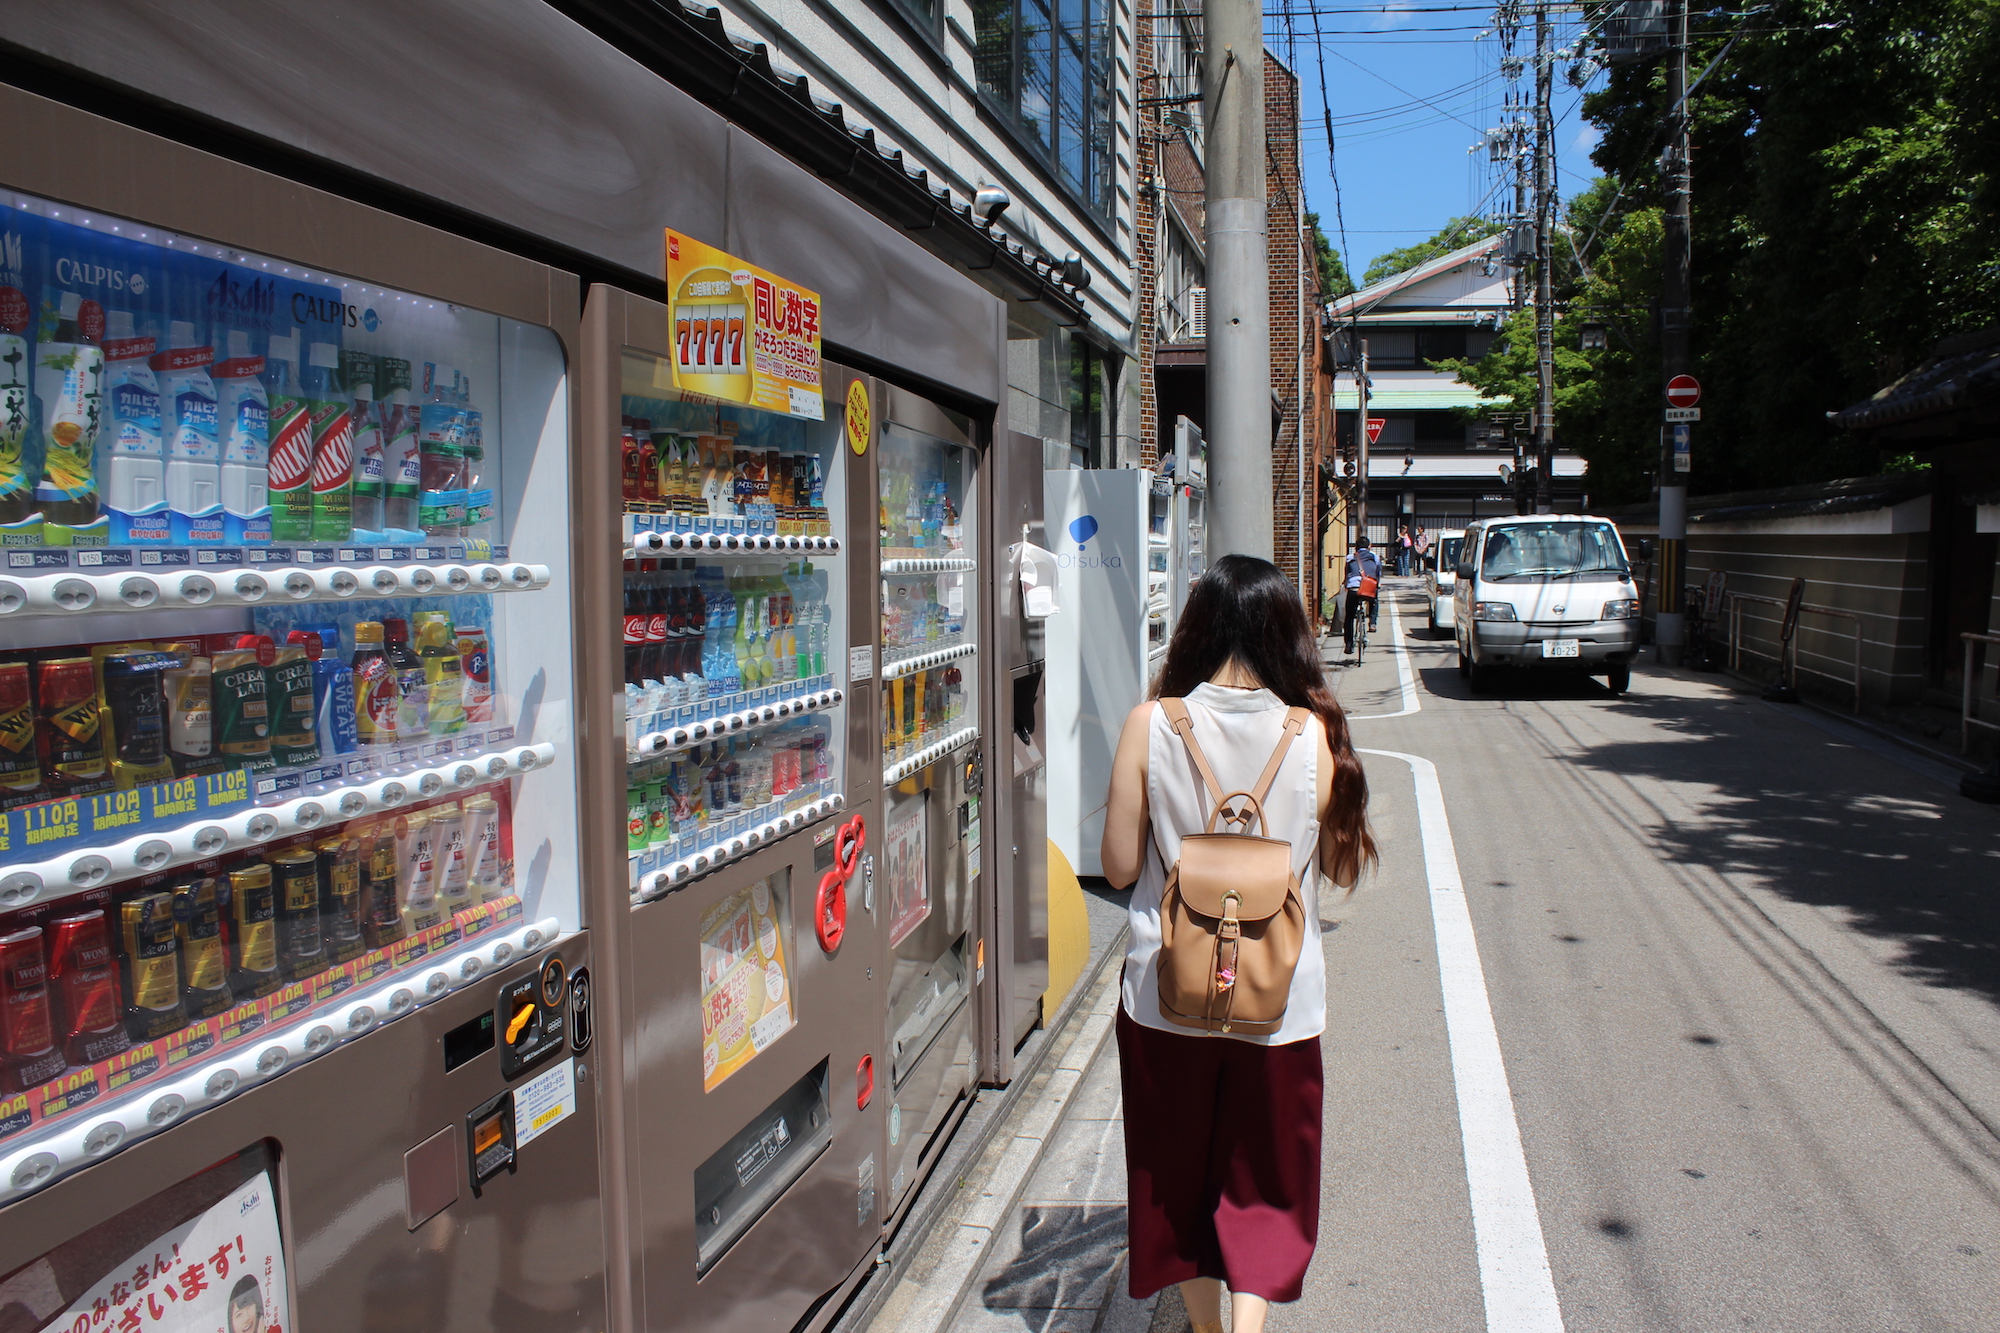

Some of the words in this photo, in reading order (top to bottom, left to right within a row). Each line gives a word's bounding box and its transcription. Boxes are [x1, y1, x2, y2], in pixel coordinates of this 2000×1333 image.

[56, 257, 123, 291] CALPIS
[207, 269, 274, 317] Asahi
[291, 292, 357, 328] CALPIS
[754, 276, 818, 344] 同じ数字
[11, 554, 30, 565] ¥150
[82, 552, 100, 563] ¥150
[1057, 553, 1121, 569] Otsuka
[1551, 646, 1577, 656] 40-25
[334, 672, 349, 737] SWEAT
[152, 778, 196, 806] 110円
[206, 769, 247, 793] 110円
[260, 781, 275, 790] ¥130
[92, 790, 140, 816] 110円
[154, 799, 196, 818] 期間限定
[208, 789, 247, 807] 期間限定
[24, 801, 78, 830] 110円
[93, 811, 141, 830] 期間限定
[26, 826, 79, 845] 期間限定
[108, 1044, 155, 1075] 110円
[42, 1068, 94, 1100] 110円
[240, 1191, 260, 1214] Asahi
[60, 1243, 182, 1333] のみなさん!
